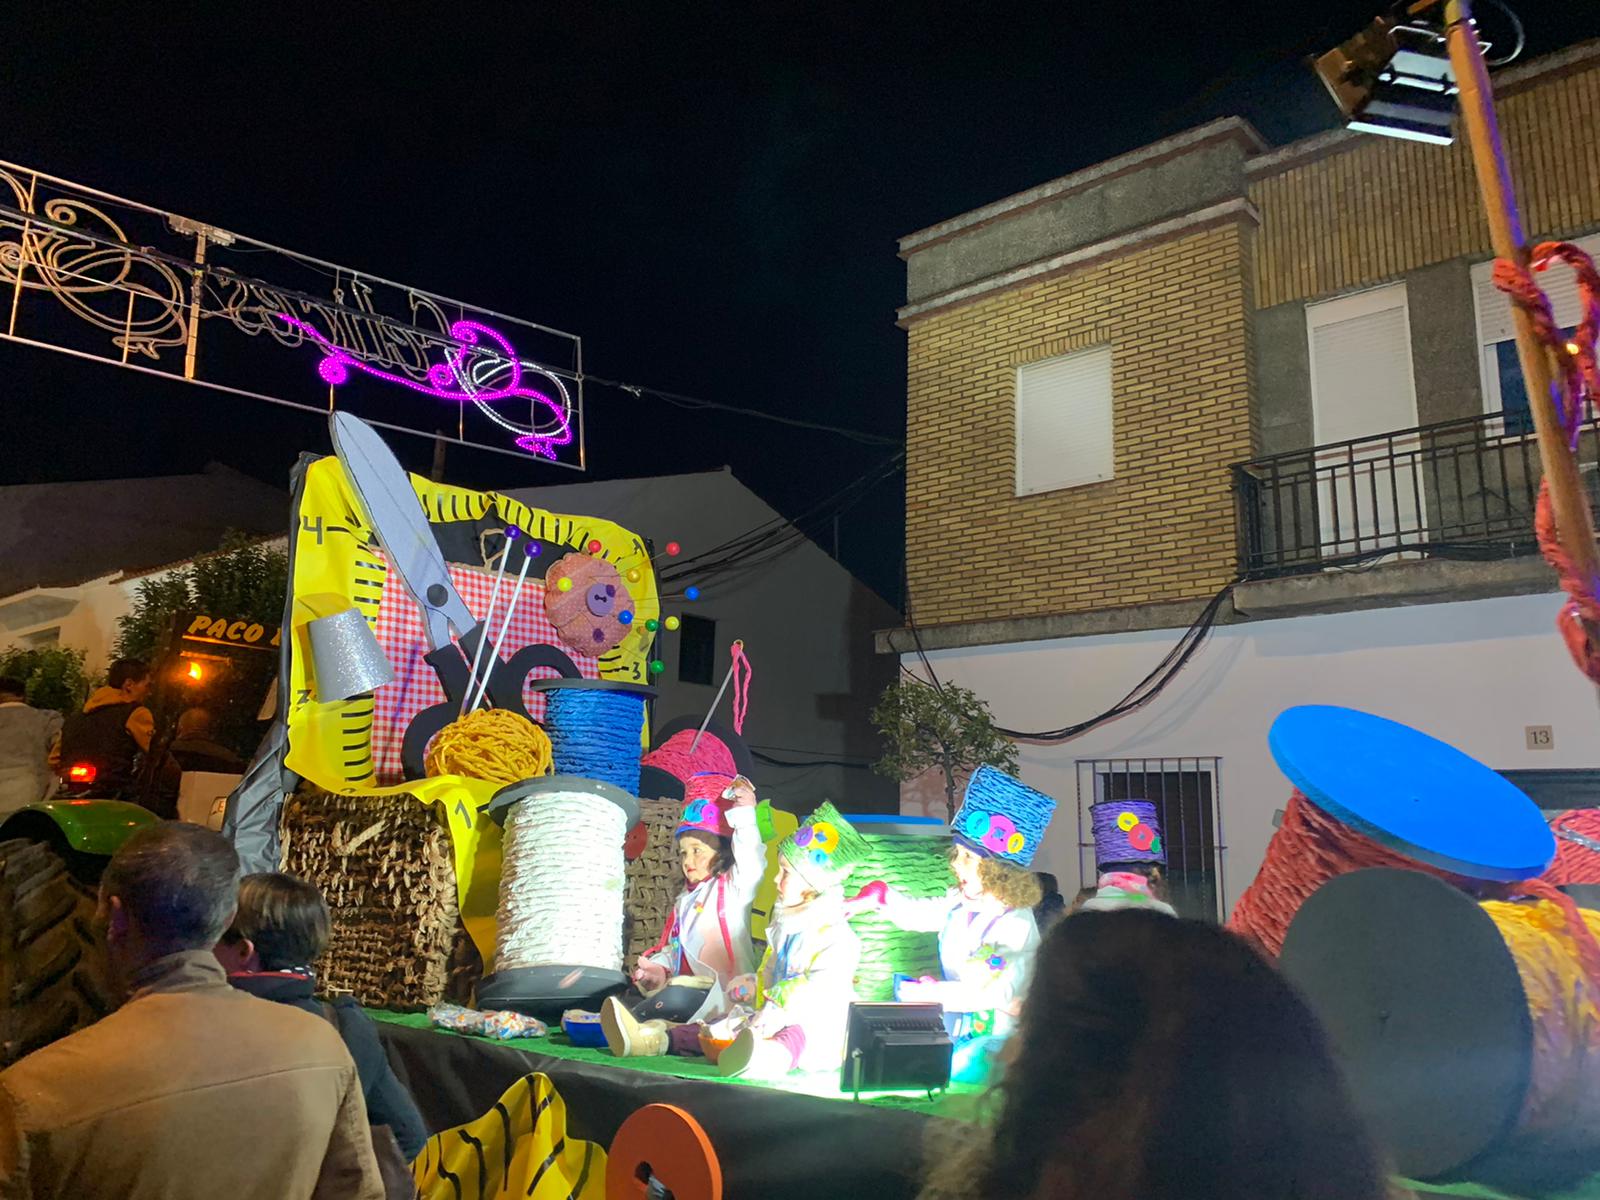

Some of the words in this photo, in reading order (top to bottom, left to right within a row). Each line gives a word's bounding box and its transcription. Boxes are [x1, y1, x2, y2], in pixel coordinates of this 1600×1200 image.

[303, 515, 323, 545] 4
[187, 615, 264, 642] PACO
[633, 661, 641, 680] 3
[1530, 730, 1550, 745] 13
[455, 799, 471, 829] 1
